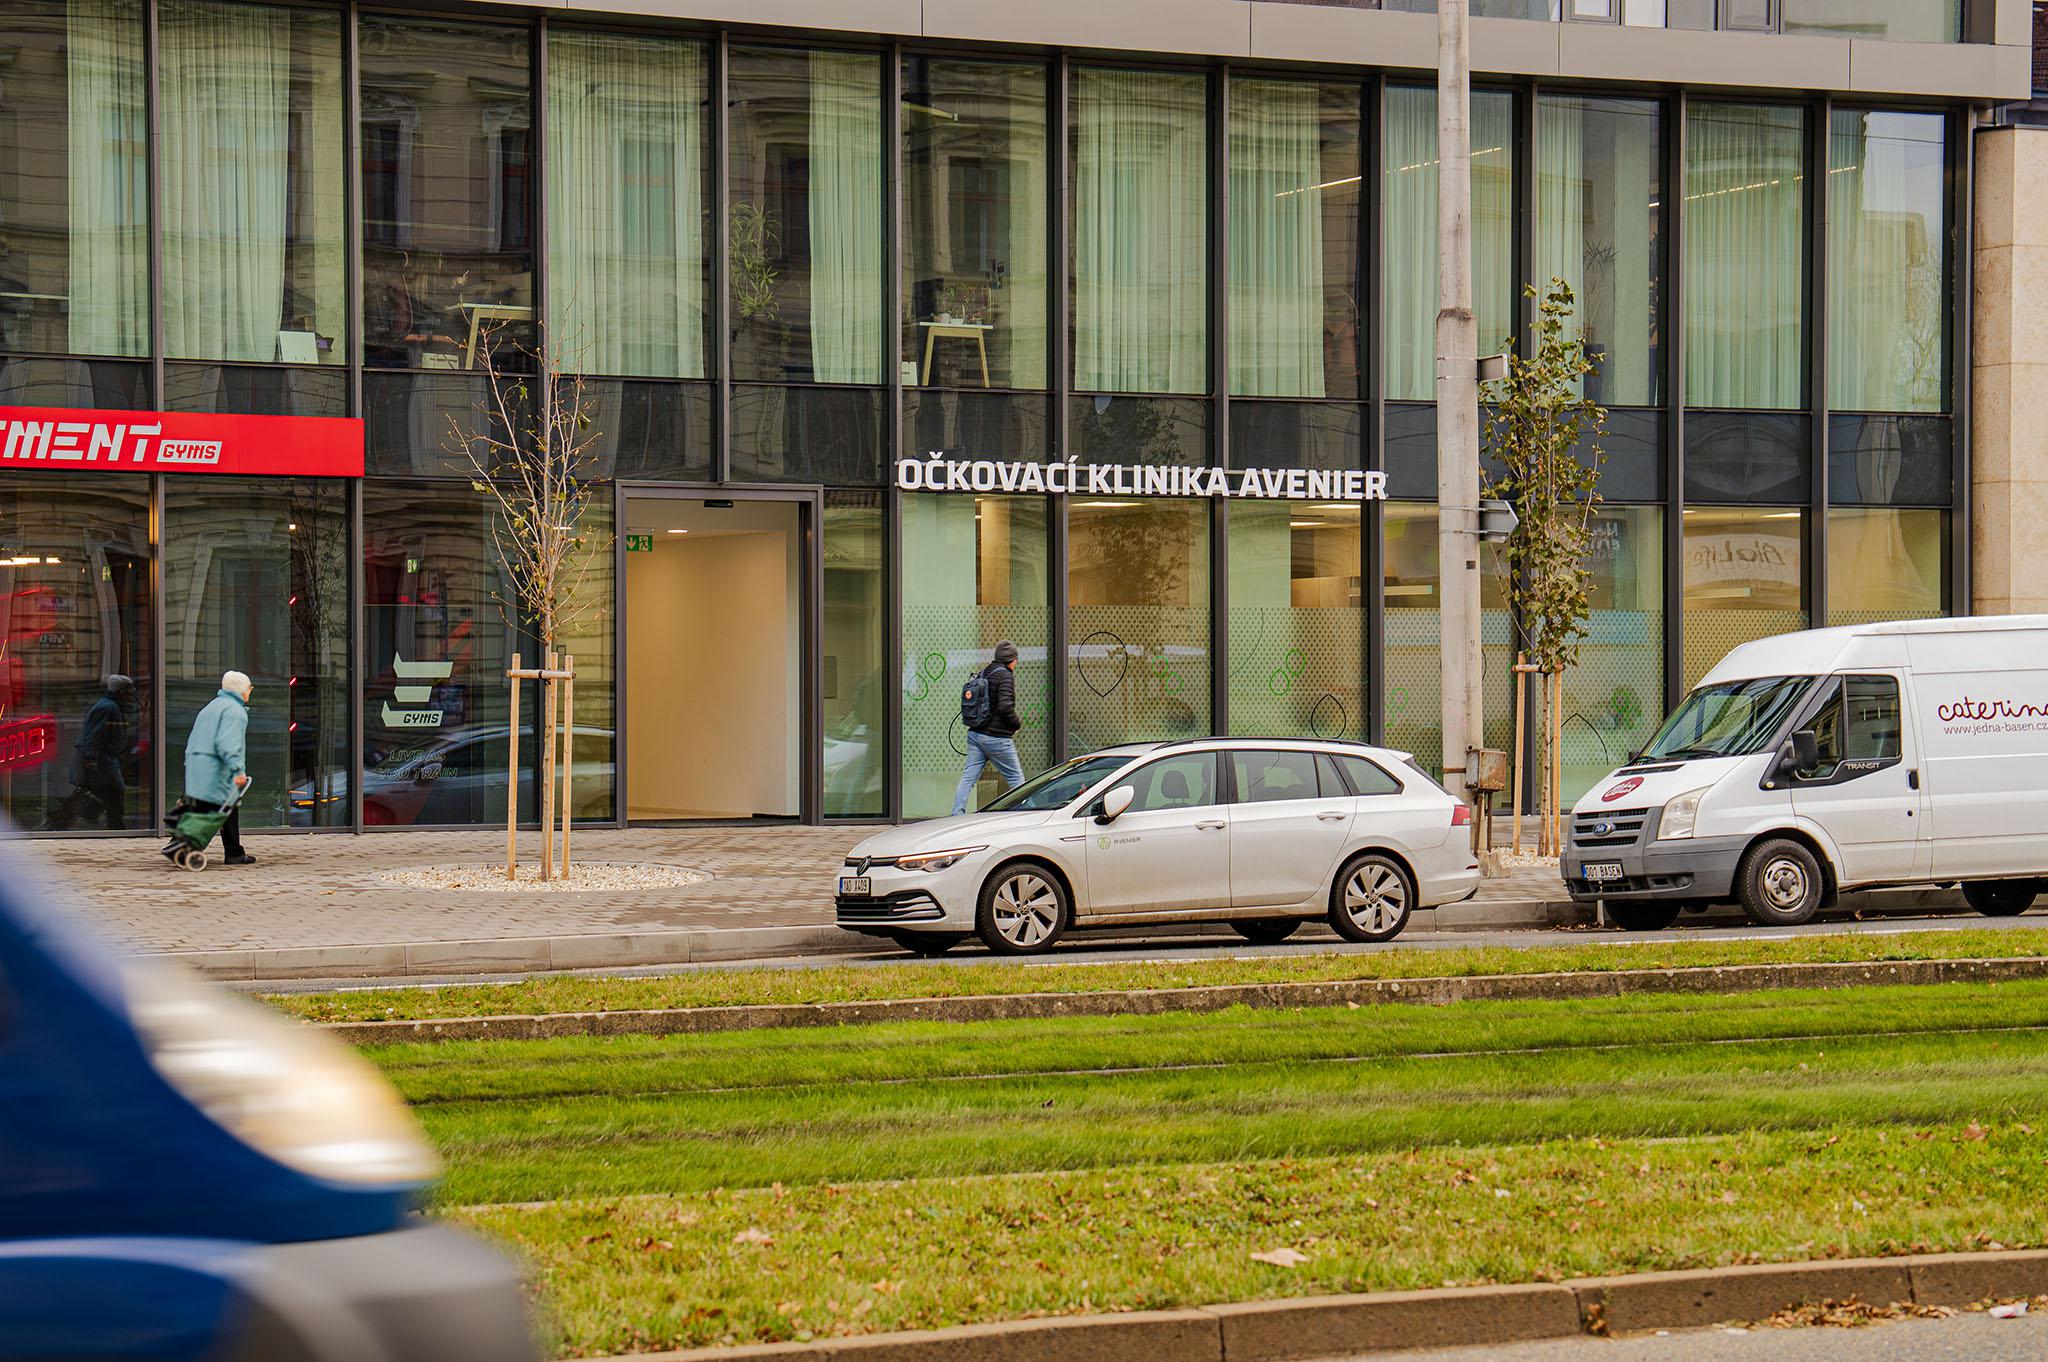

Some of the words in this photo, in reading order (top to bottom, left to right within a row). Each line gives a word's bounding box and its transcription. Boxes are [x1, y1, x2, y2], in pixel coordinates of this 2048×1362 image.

[0, 420, 162, 462] MENT
[163, 444, 216, 459] GYMS
[898, 451, 1079, 493] OČKOVACÍ
[1088, 464, 1230, 497] KLINIKA
[1238, 468, 1387, 500] AVENIER
[403, 713, 440, 724] GYMS
[1943, 722, 2048, 735] www.jedna-basen.cz
[389, 750, 423, 762] LIVE
[425, 750, 446, 762] AS
[1846, 762, 1880, 770] TRANSIT
[378, 767, 410, 779] YOU
[414, 767, 459, 779] TRAIN
